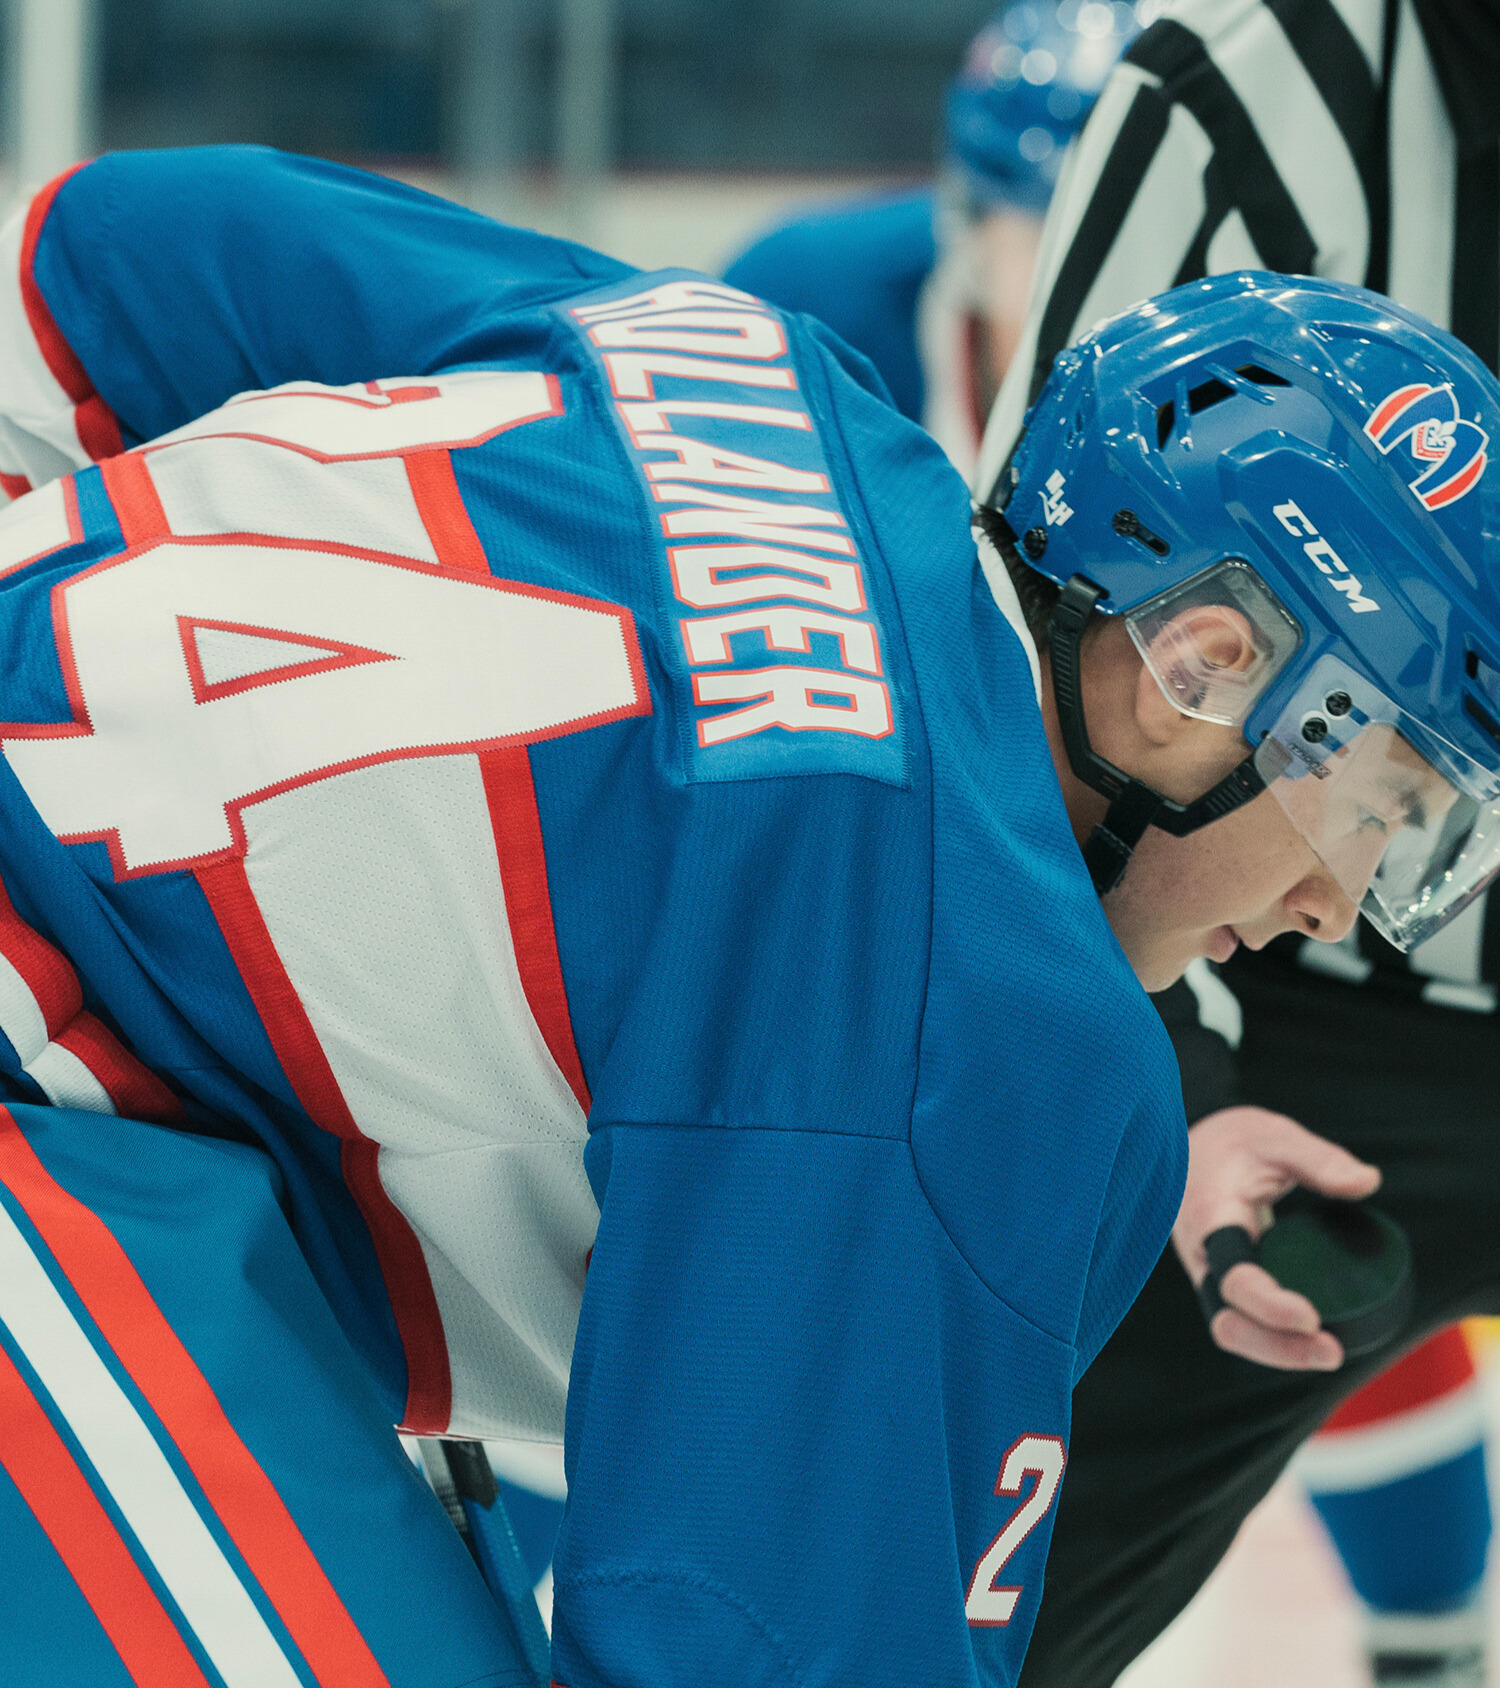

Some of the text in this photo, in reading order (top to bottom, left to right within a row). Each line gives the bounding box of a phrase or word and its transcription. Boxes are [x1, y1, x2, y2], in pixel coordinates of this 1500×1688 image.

[568, 280, 895, 749] HOLLANDER
[1272, 498, 1381, 614] CCM
[963, 1432, 1067, 1627] 2
